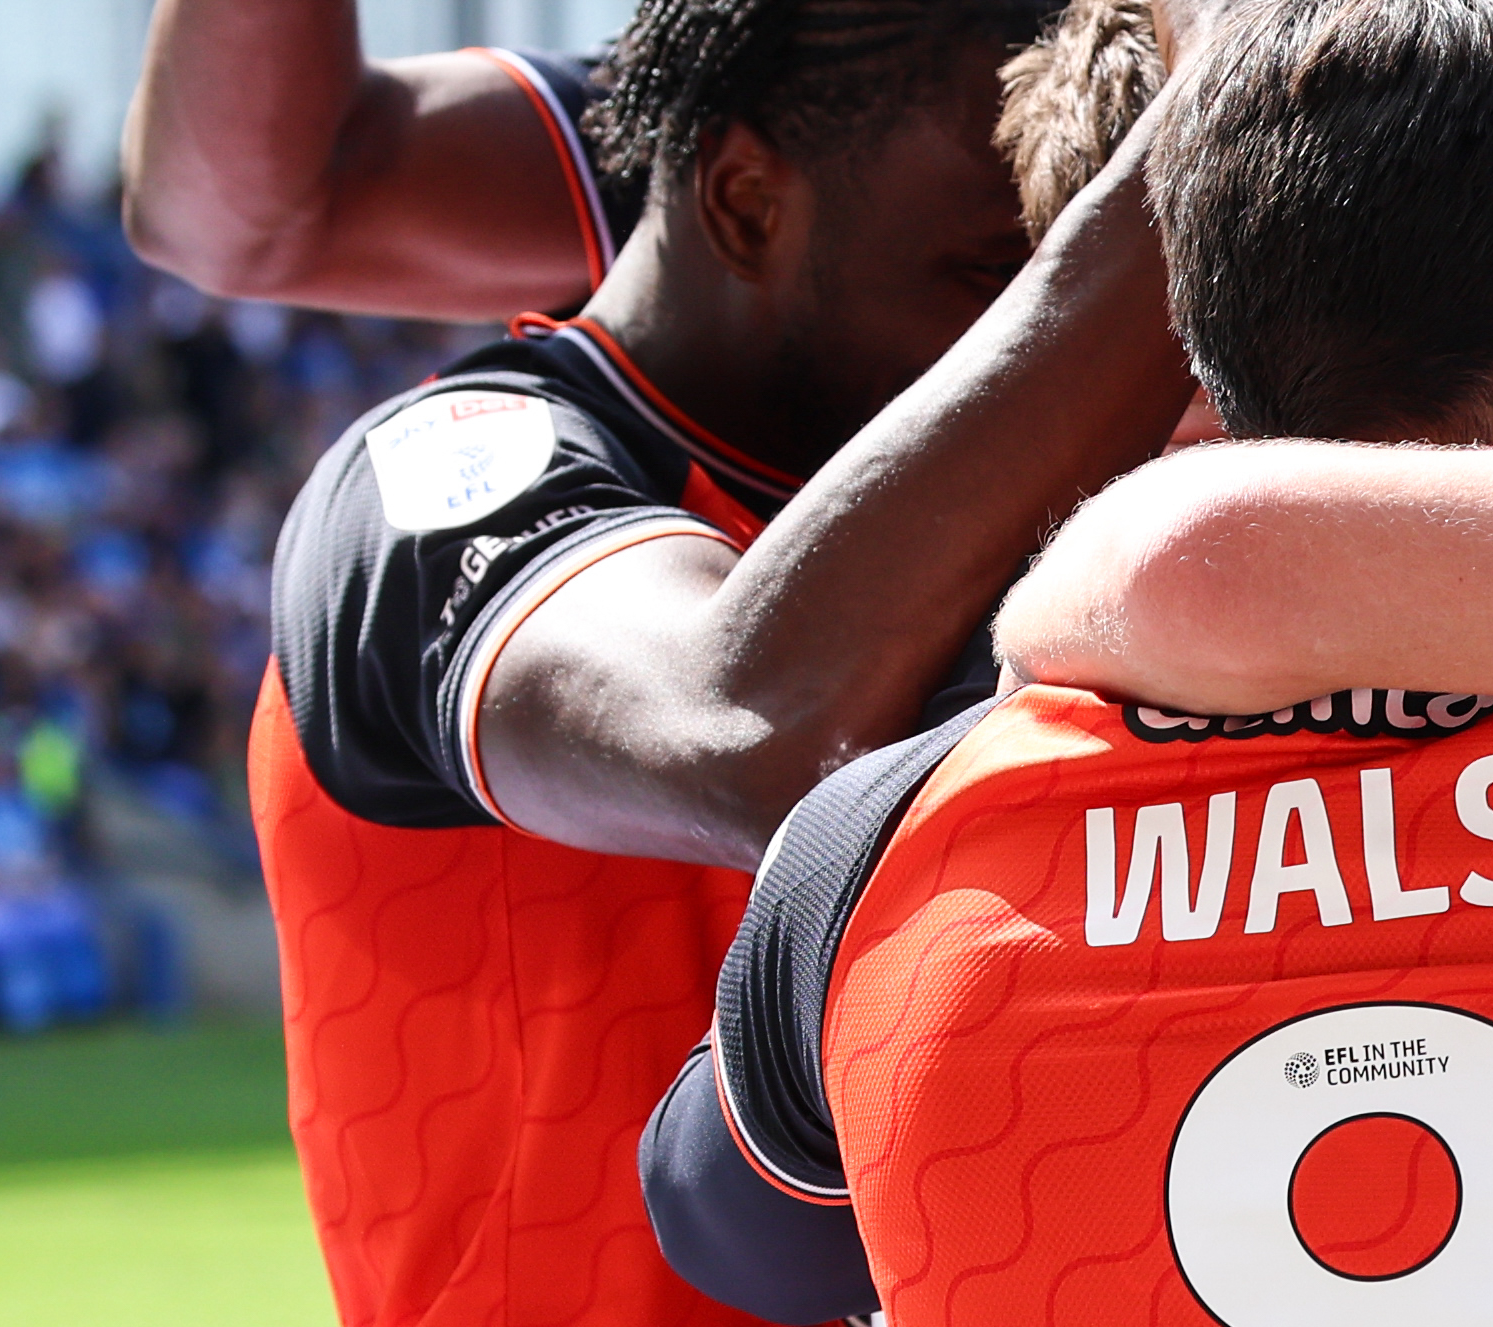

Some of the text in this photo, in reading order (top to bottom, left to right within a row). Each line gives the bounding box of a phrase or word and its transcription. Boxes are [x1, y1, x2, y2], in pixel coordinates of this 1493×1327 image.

[447, 480, 496, 510] EFL
[1324, 1038, 1428, 1066] EFL IN THE
[1327, 1055, 1450, 1086] COMMUNITY
